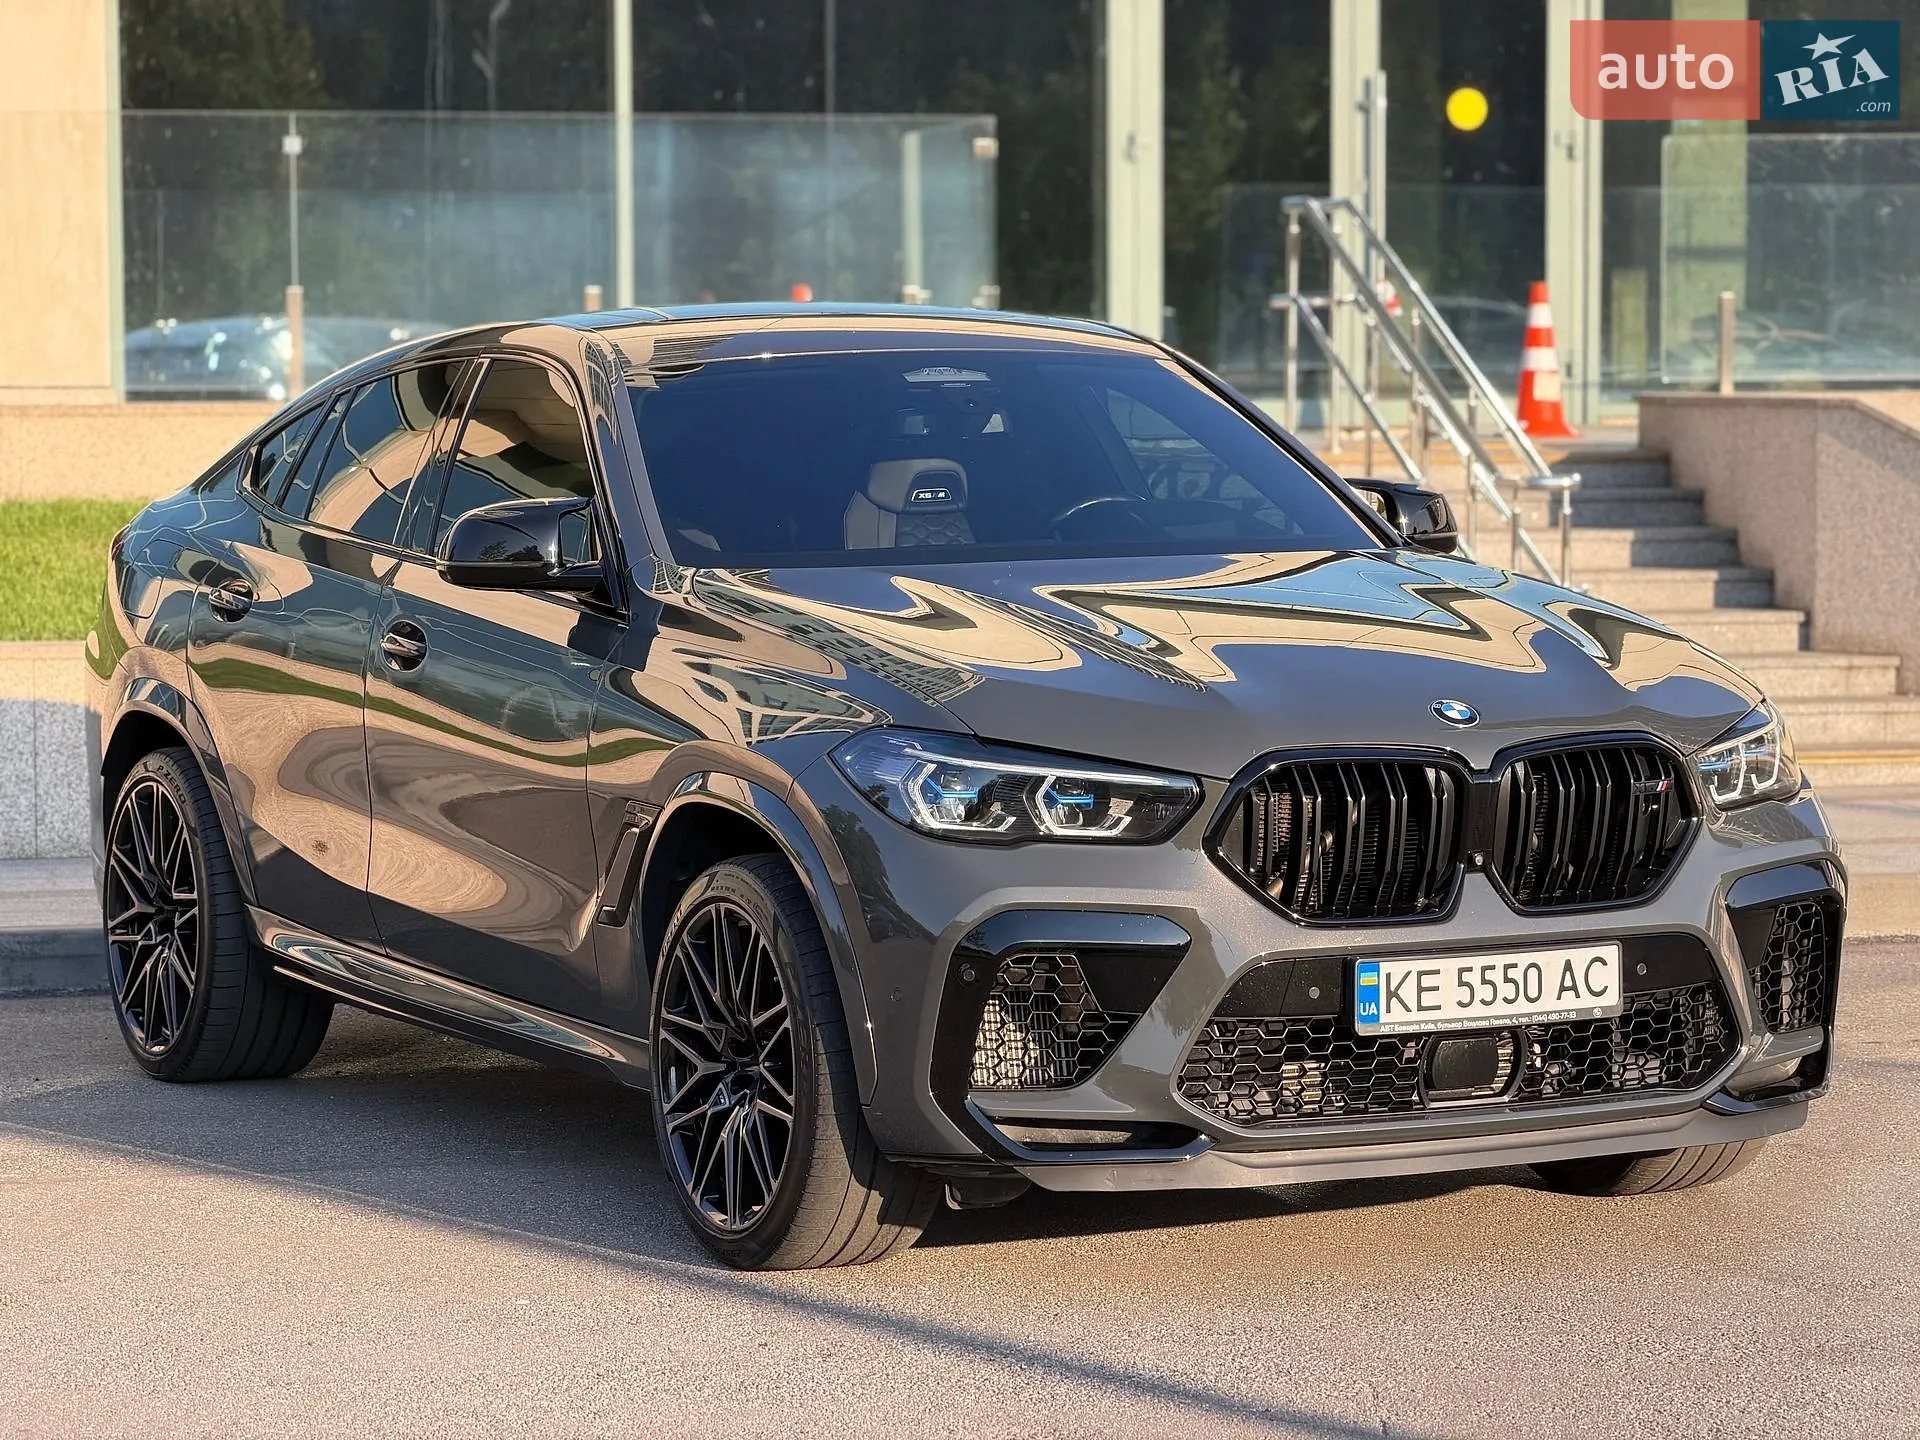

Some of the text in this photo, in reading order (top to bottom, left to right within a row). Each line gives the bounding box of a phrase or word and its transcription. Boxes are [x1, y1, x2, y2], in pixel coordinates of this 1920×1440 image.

[1385, 956, 1609, 1014] KE 5550 AC
[1360, 1001, 1378, 1016] UA
[1548, 1011, 1577, 1021] 490-77-33
